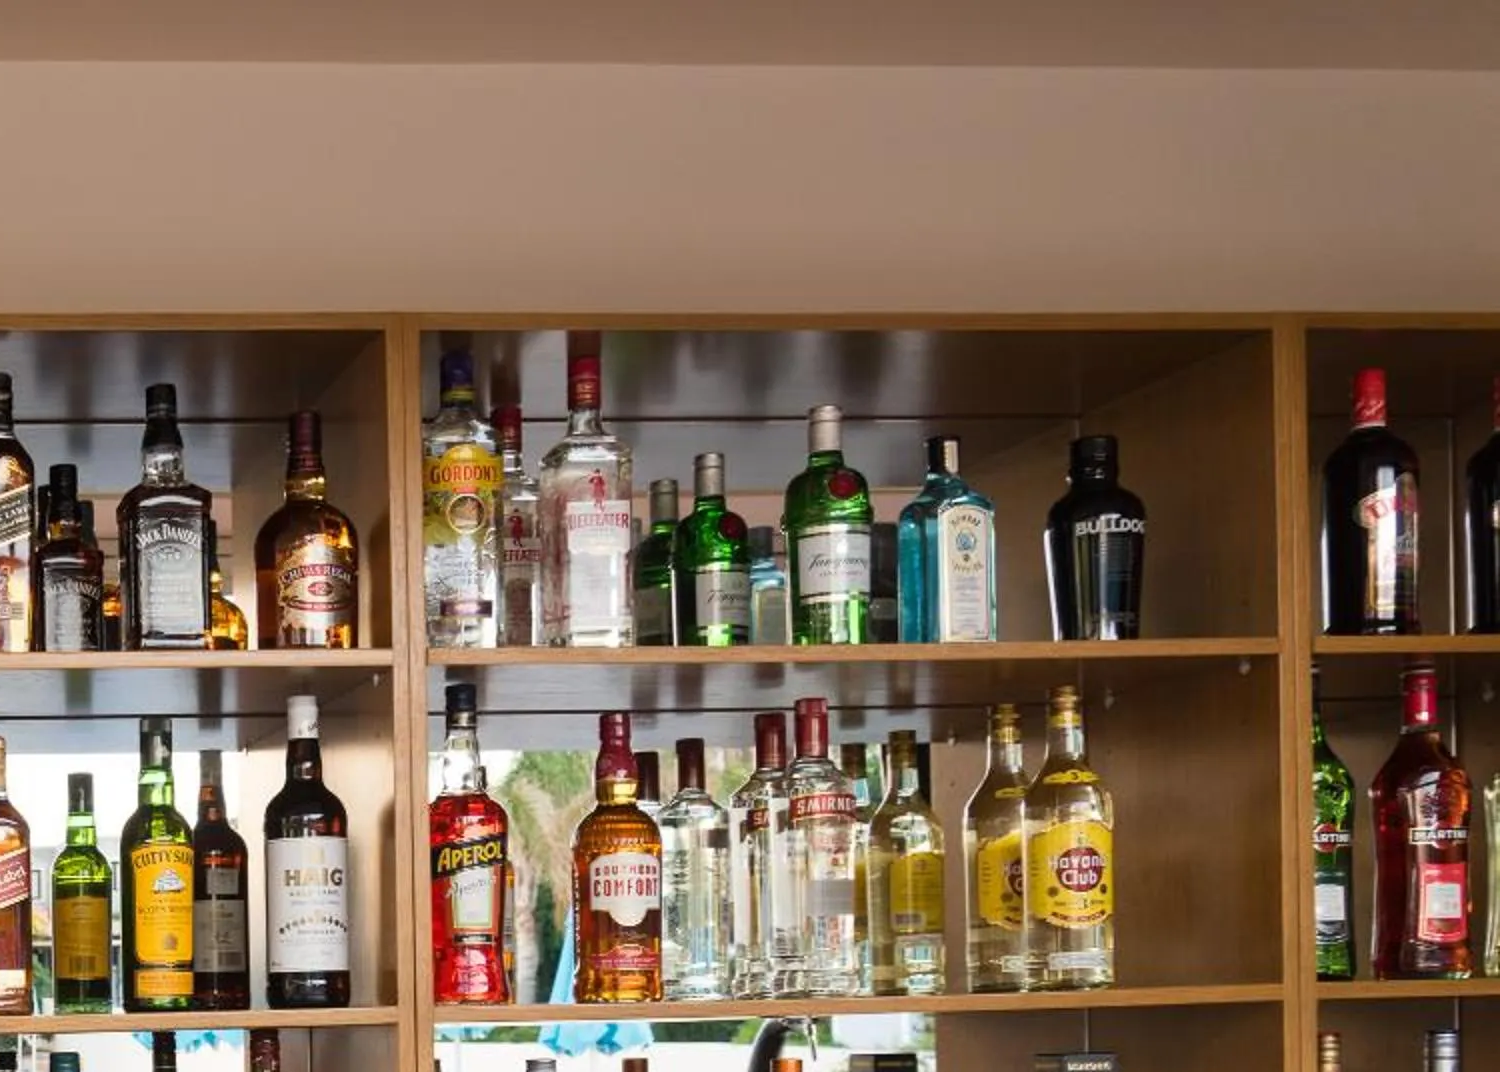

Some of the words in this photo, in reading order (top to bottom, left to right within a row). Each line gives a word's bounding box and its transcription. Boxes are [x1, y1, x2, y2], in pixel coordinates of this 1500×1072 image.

[436, 841, 503, 873] APEROL
[284, 867, 343, 887] HAIG
[1061, 869, 1098, 886] Club
[593, 878, 658, 898] COMFORT
